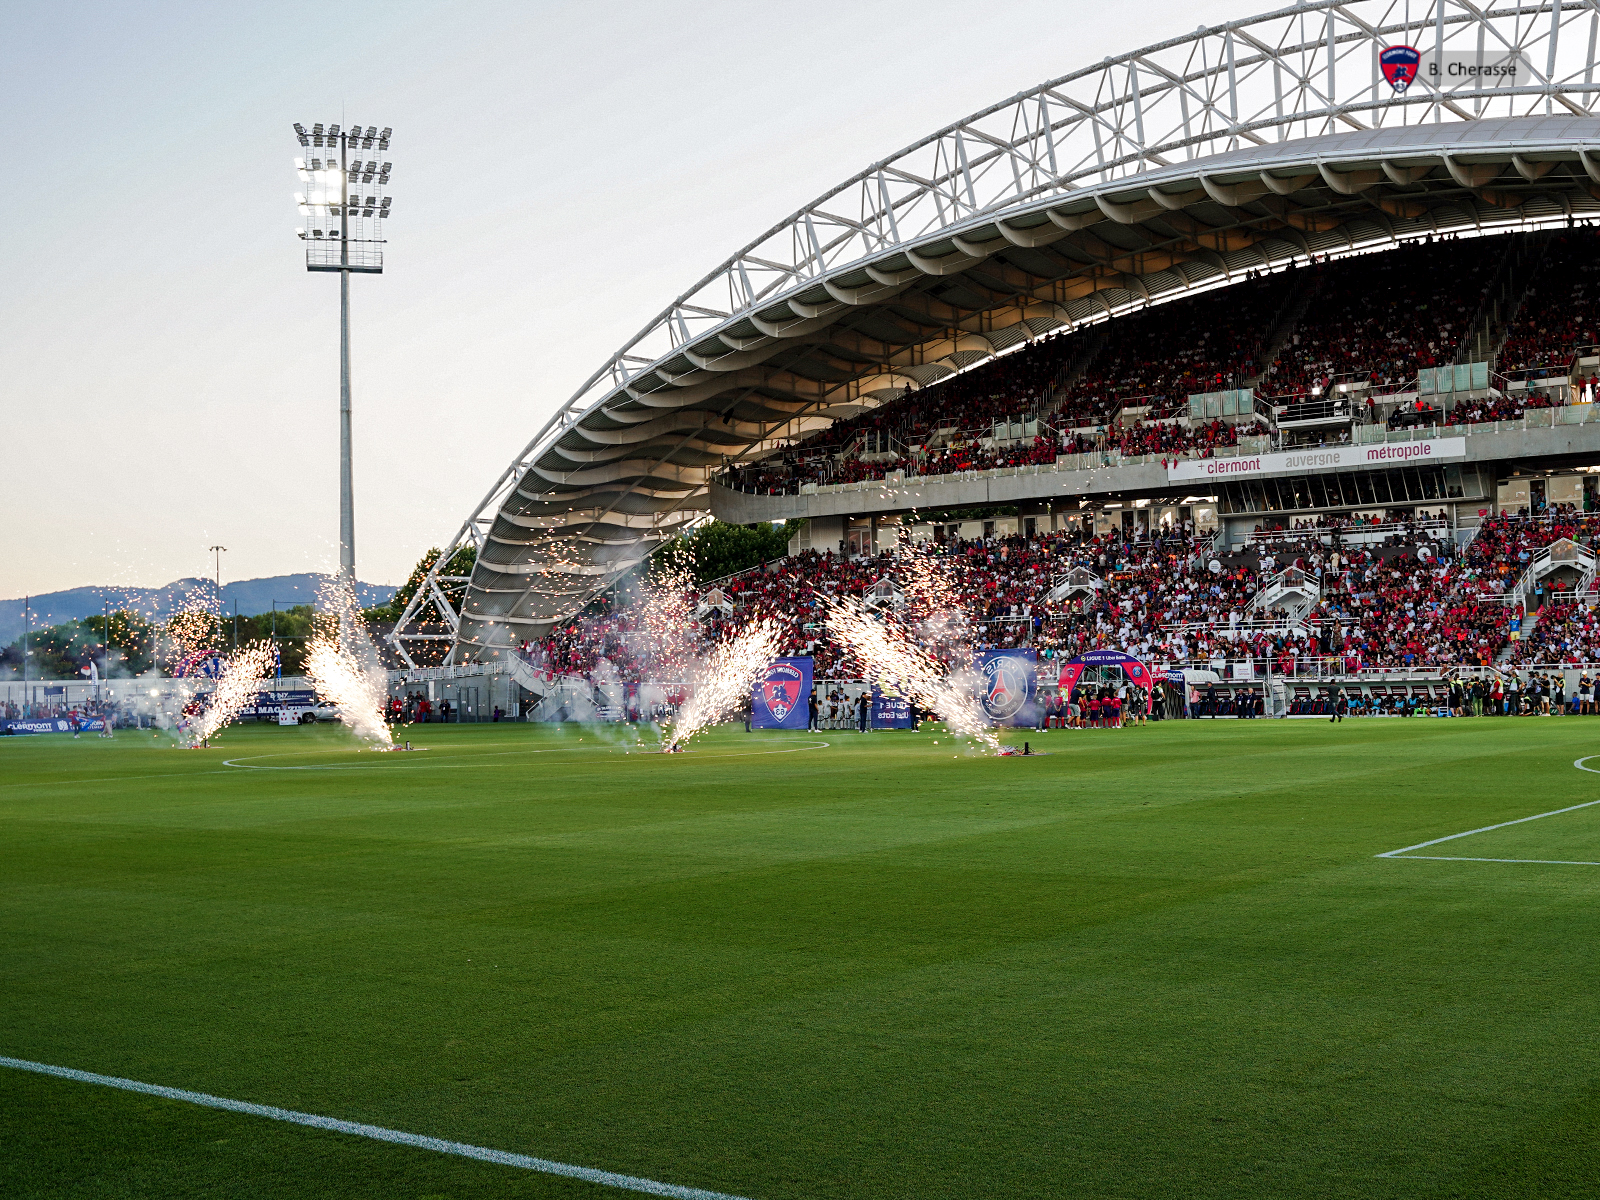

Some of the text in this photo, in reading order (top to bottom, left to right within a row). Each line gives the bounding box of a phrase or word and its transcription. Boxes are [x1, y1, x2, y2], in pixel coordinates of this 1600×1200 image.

[1207, 441, 1432, 474] clermont auvergne métropole
